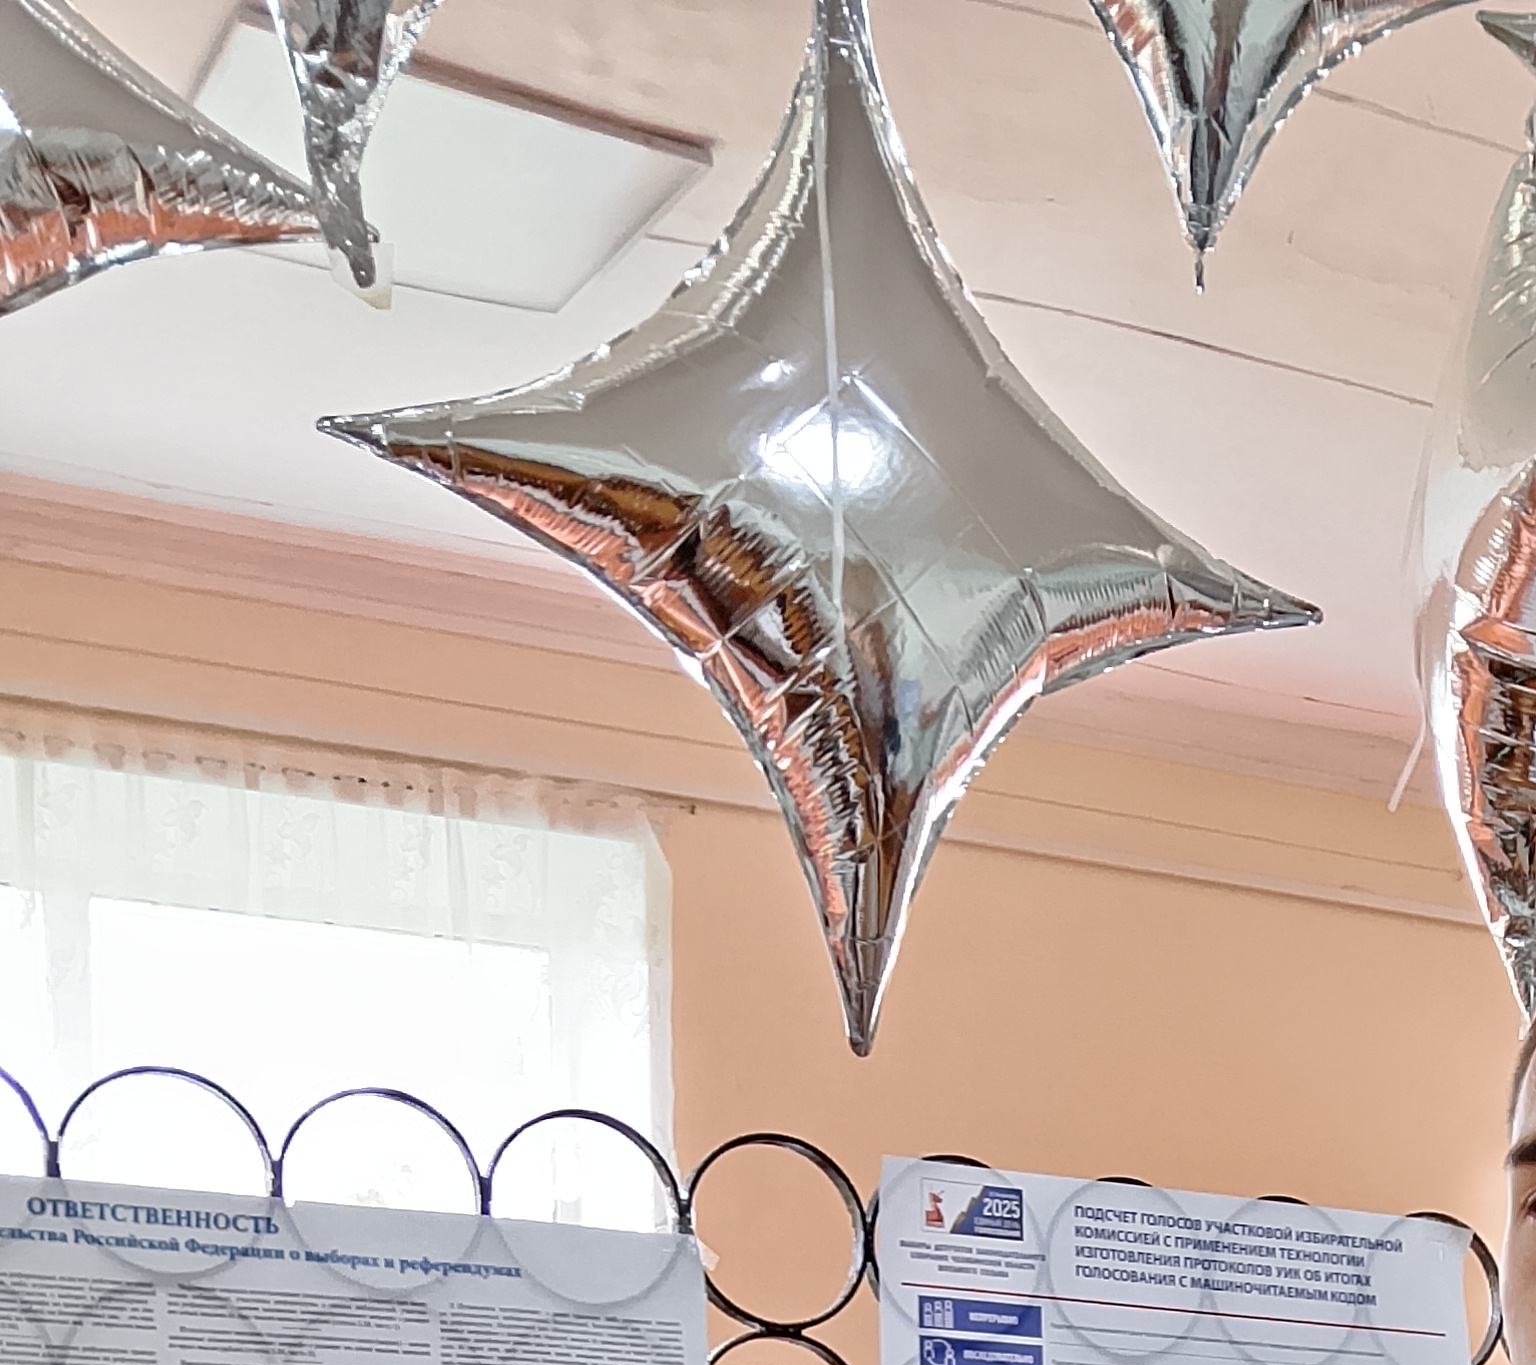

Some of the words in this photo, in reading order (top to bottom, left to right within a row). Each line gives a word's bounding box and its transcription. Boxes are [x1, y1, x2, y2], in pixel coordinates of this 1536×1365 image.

[27, 1197, 279, 1234] ОТВЕТСТВЕННОСТЬ
[983, 1198, 1020, 1218] 2025
[1074, 1205, 1138, 1223] ПОДСЧЕТ
[1141, 1212, 1201, 1230] ГОЛОСОВ
[1205, 1219, 1292, 1241] УЧАСТКОВОЙ
[1296, 1230, 1403, 1252] ИЗБИРАТЕЛЬНОЙ
[72, 1229, 180, 1251] Российской
[185, 1238, 284, 1261] Федерации
[291, 1251, 300, 1261] о
[305, 1250, 379, 1270] выборах
[384, 1257, 394, 1268] и
[399, 1256, 521, 1279] референдумах
[1074, 1225, 1160, 1246] КОМИССИЕЙ
[1163, 1235, 1171, 1247] С
[1174, 1236, 1276, 1258] ПРИМЕНЕНИЕМ
[1279, 1247, 1364, 1267] ТЕХНОЛОГИИ
[1075, 1245, 1180, 1267] ИЗГОТОВЛЕНИЯ
[1184, 1257, 1272, 1277] ПРОТОКОЛОВ
[1276, 1266, 1300, 1280] УИК
[1304, 1269, 1321, 1282] ОБ
[1324, 1272, 1371, 1287] ИТОГАХ
[1075, 1265, 1175, 1286] ГОЛОСОВАНИЯ
[1179, 1275, 1187, 1287] С
[1190, 1277, 1328, 1301] МАШИНОЧИТАЕМЫМ
[1330, 1291, 1376, 1306] КОДОМ
